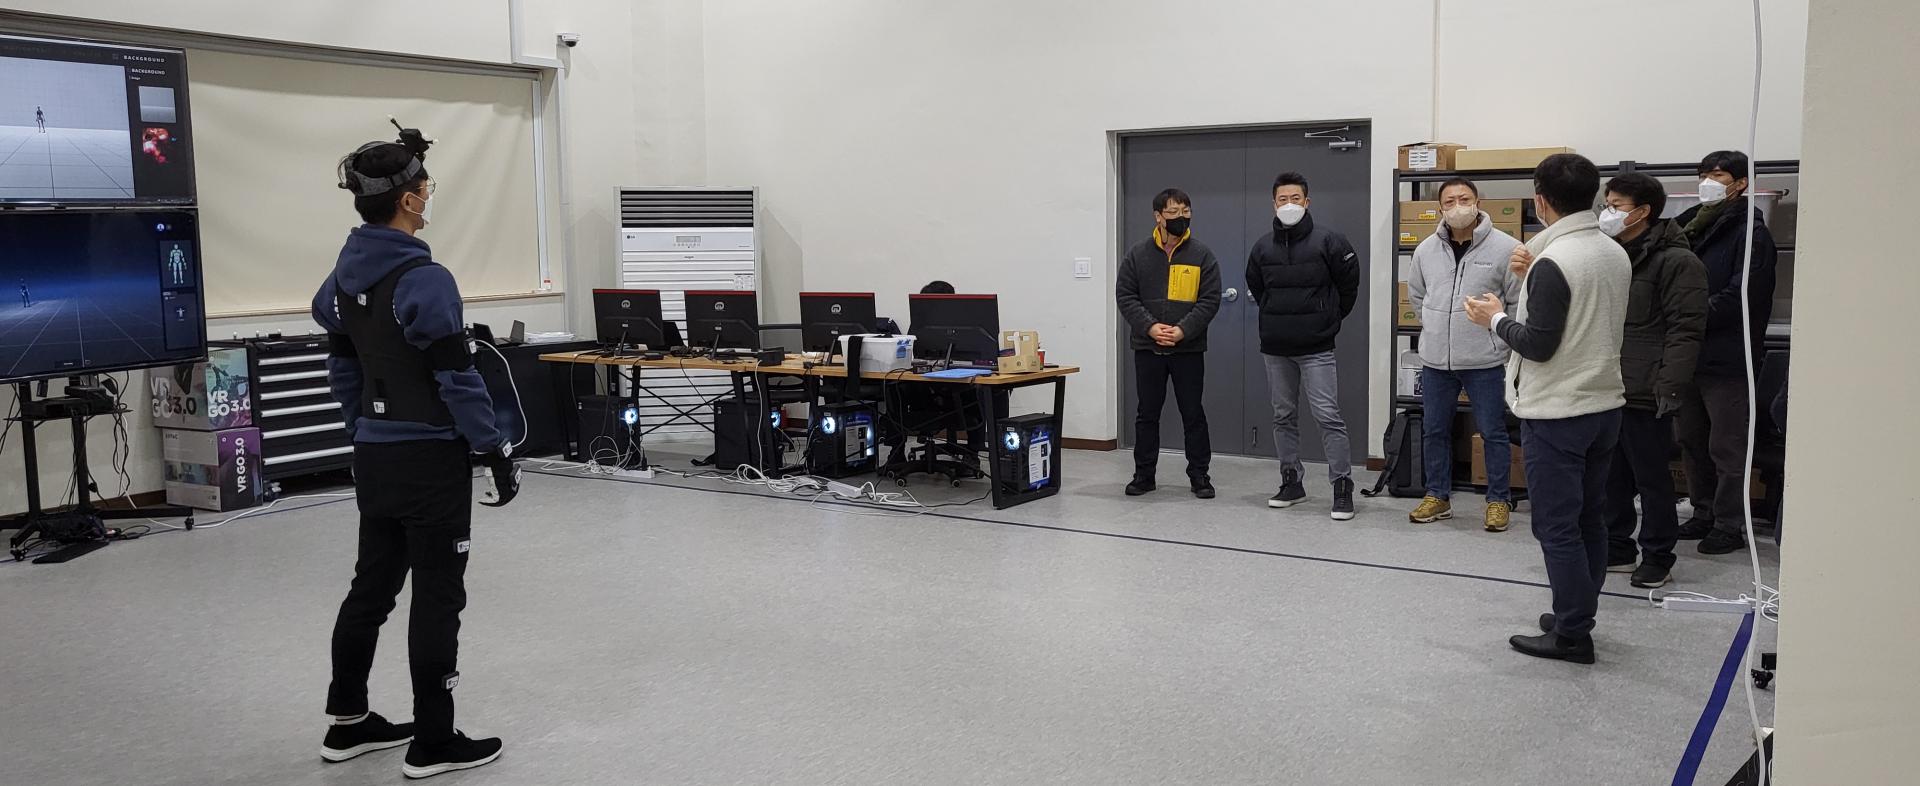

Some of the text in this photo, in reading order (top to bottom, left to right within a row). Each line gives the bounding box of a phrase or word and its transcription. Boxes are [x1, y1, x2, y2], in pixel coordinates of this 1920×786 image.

[123, 55, 165, 63] BACKGROUND
[151, 376, 171, 397] VR
[207, 390, 229, 402] VR
[173, 397, 197, 416] 3.0
[208, 400, 251, 418] GO 3.0
[235, 437, 247, 493] VR GO 3.0
